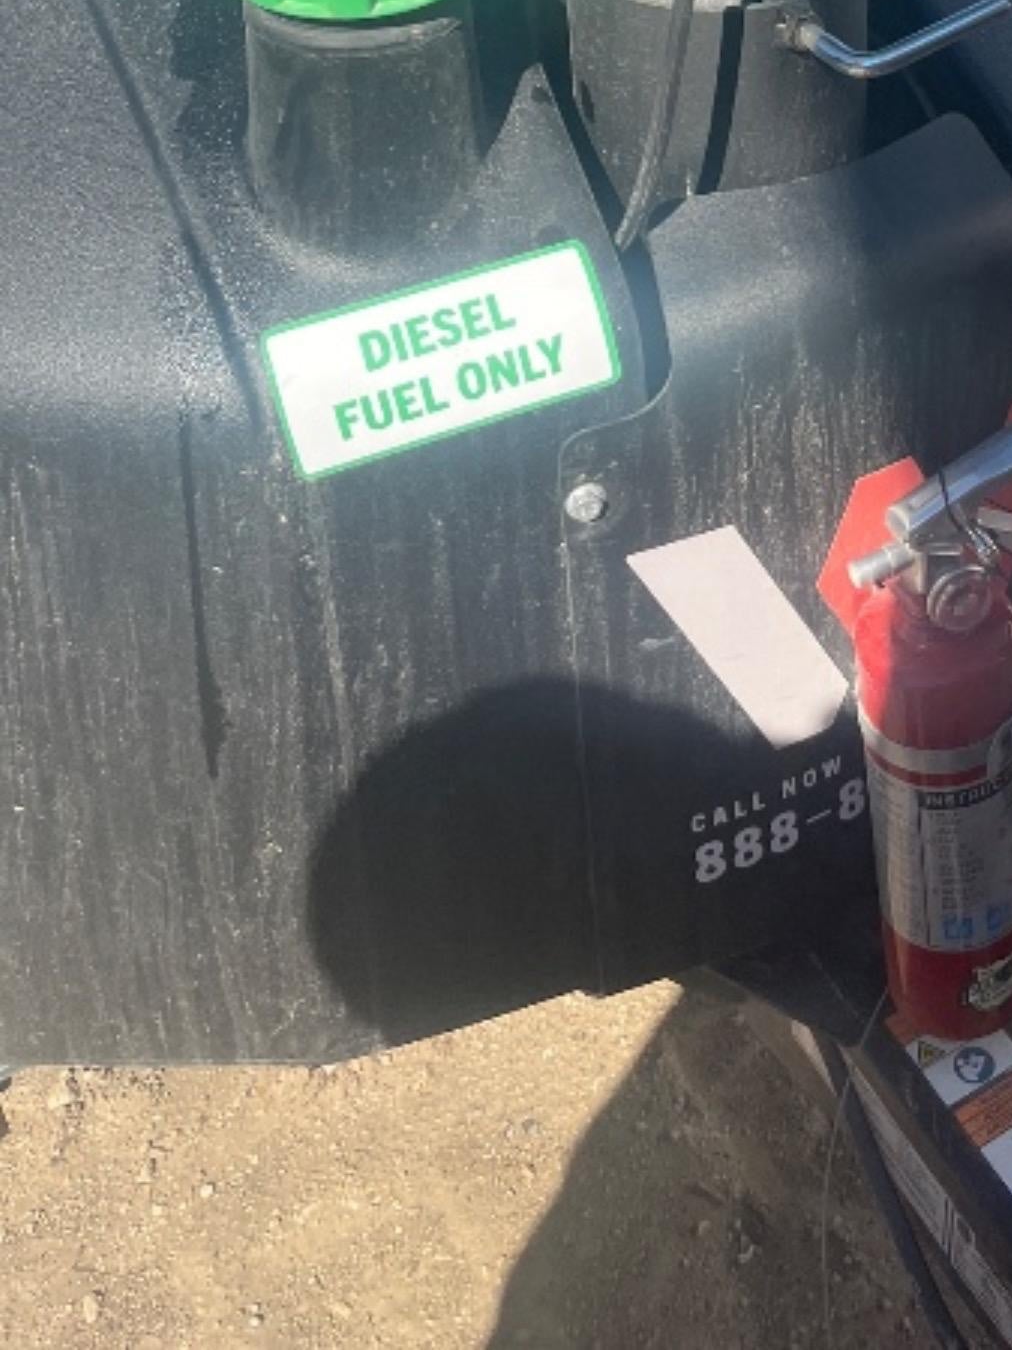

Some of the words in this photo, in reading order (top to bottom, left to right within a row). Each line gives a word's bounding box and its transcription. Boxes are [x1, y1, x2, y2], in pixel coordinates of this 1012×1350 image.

[358, 293, 516, 373] DIESEL
[332, 376, 450, 441] FUEL
[456, 332, 563, 400] ONLY
[691, 791, 766, 832] CALL
[782, 755, 841, 799] NOW
